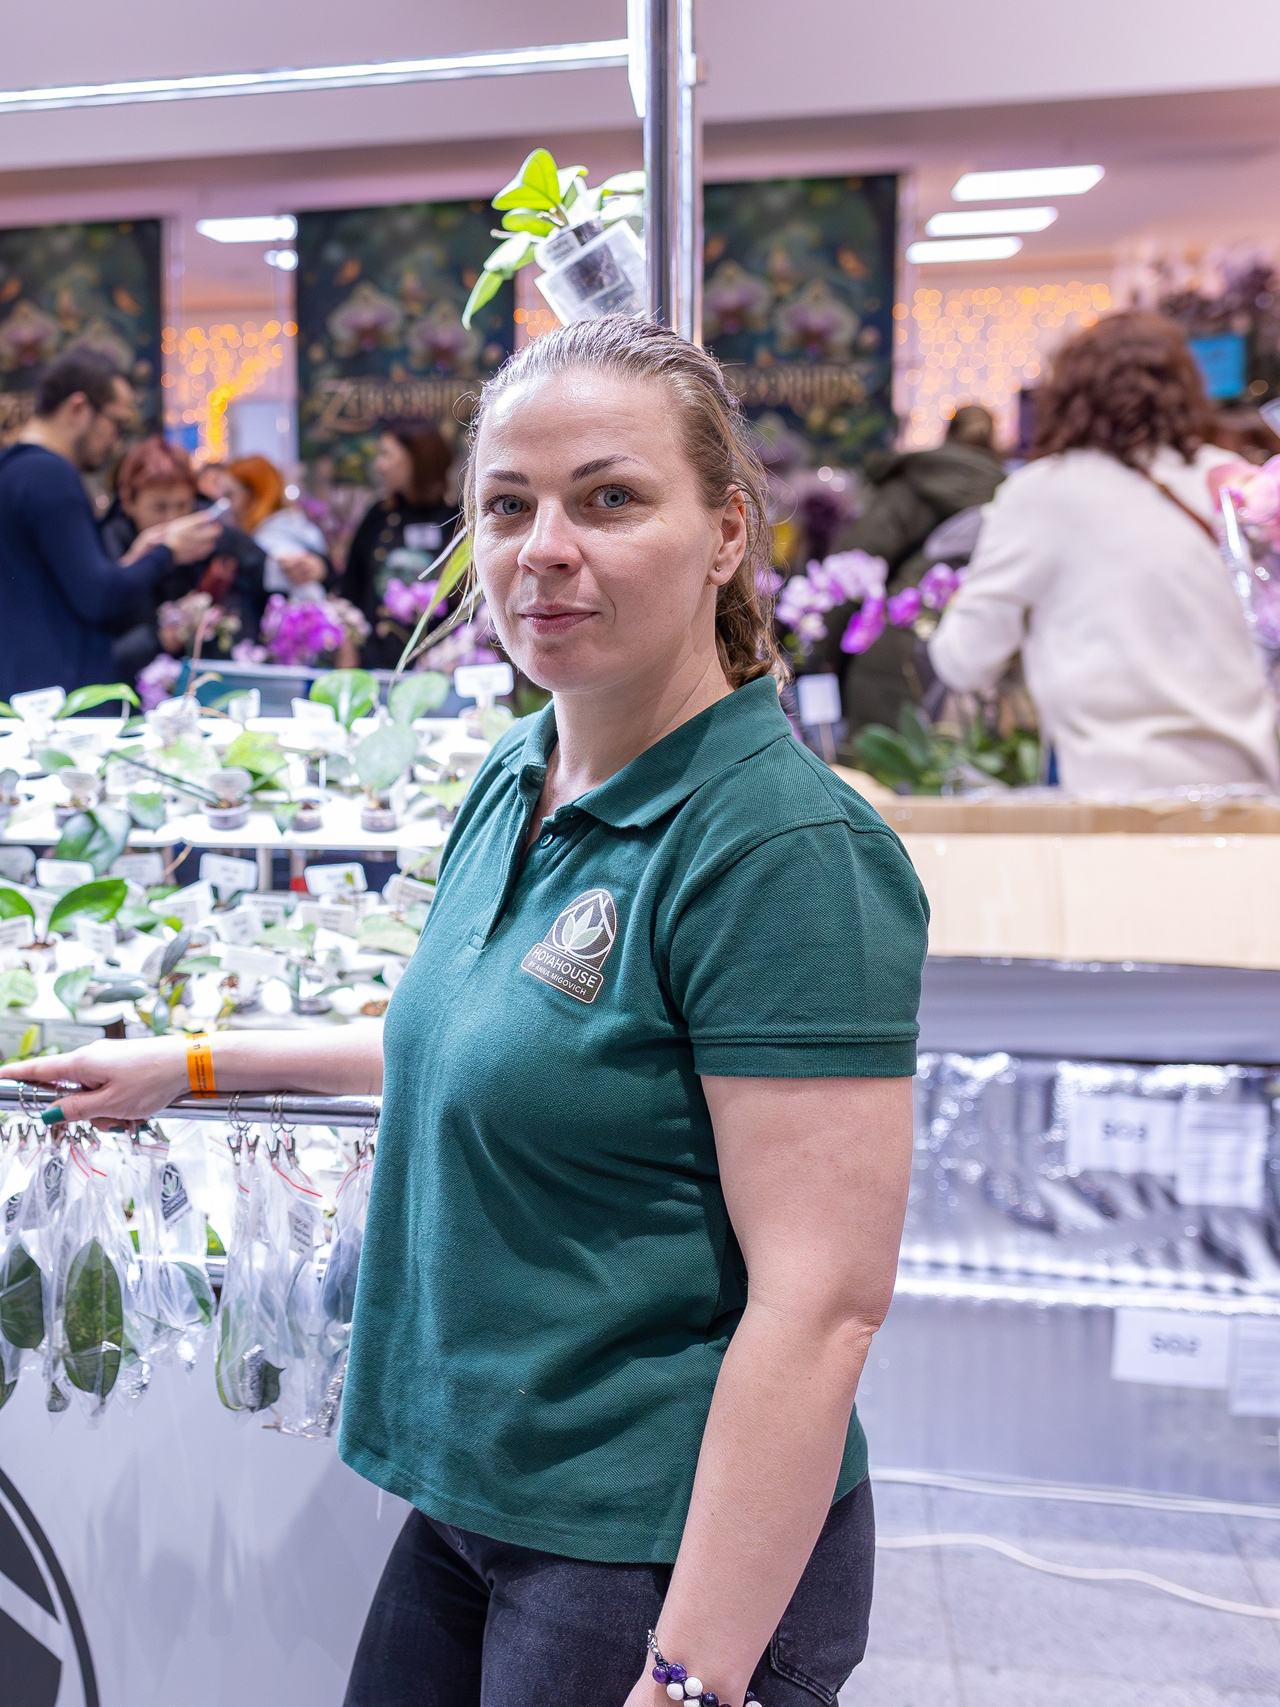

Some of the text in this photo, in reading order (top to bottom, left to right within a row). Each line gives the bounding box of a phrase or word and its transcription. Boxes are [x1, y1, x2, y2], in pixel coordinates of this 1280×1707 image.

[531, 946, 598, 988] HOYAHOUSE
[535, 963, 550, 977] ANNA
[550, 972, 587, 996] MIGOVICH
